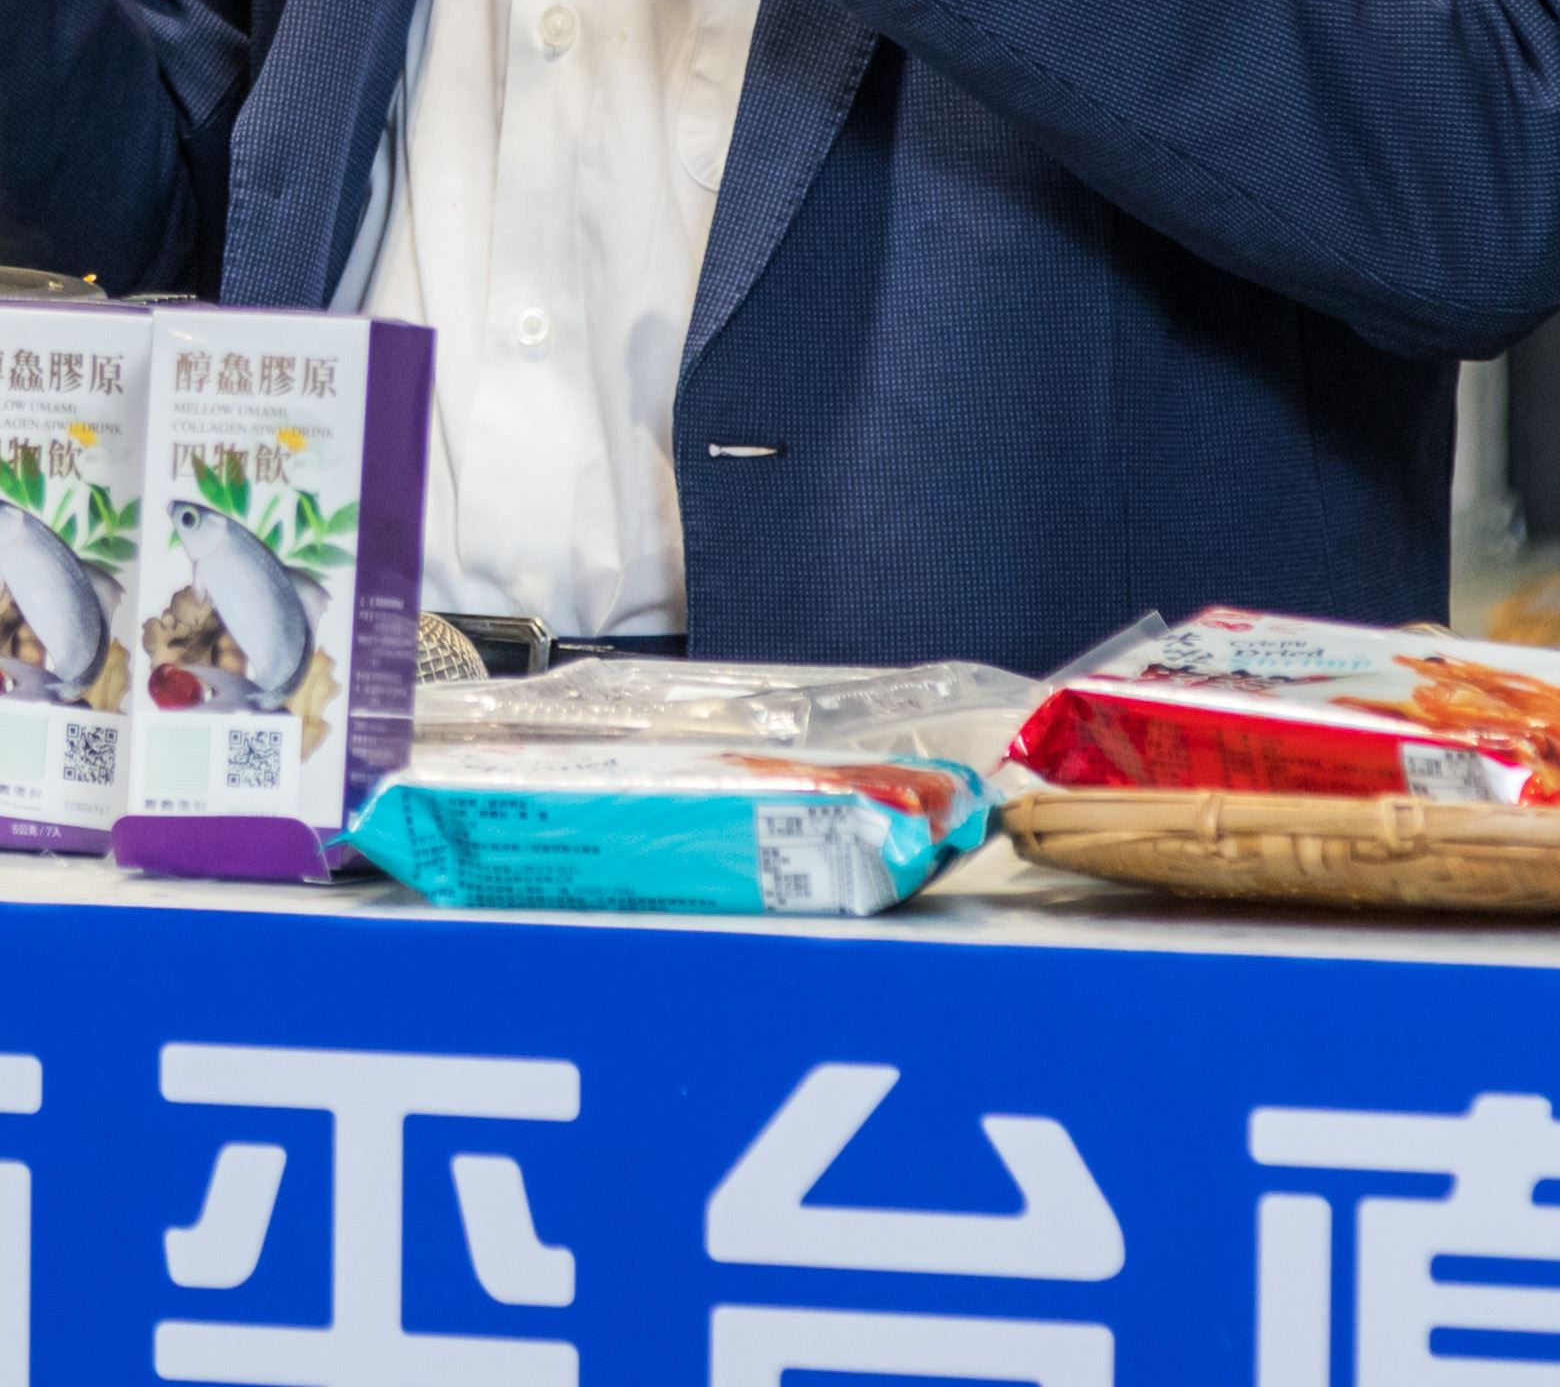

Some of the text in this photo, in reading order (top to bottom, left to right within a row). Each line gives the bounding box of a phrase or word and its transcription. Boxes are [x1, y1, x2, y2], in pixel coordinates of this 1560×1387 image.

[30, 401, 77, 415] UMAMI
[173, 402, 288, 419] MELLOW UMAMI
[172, 441, 294, 485] 四物飲
